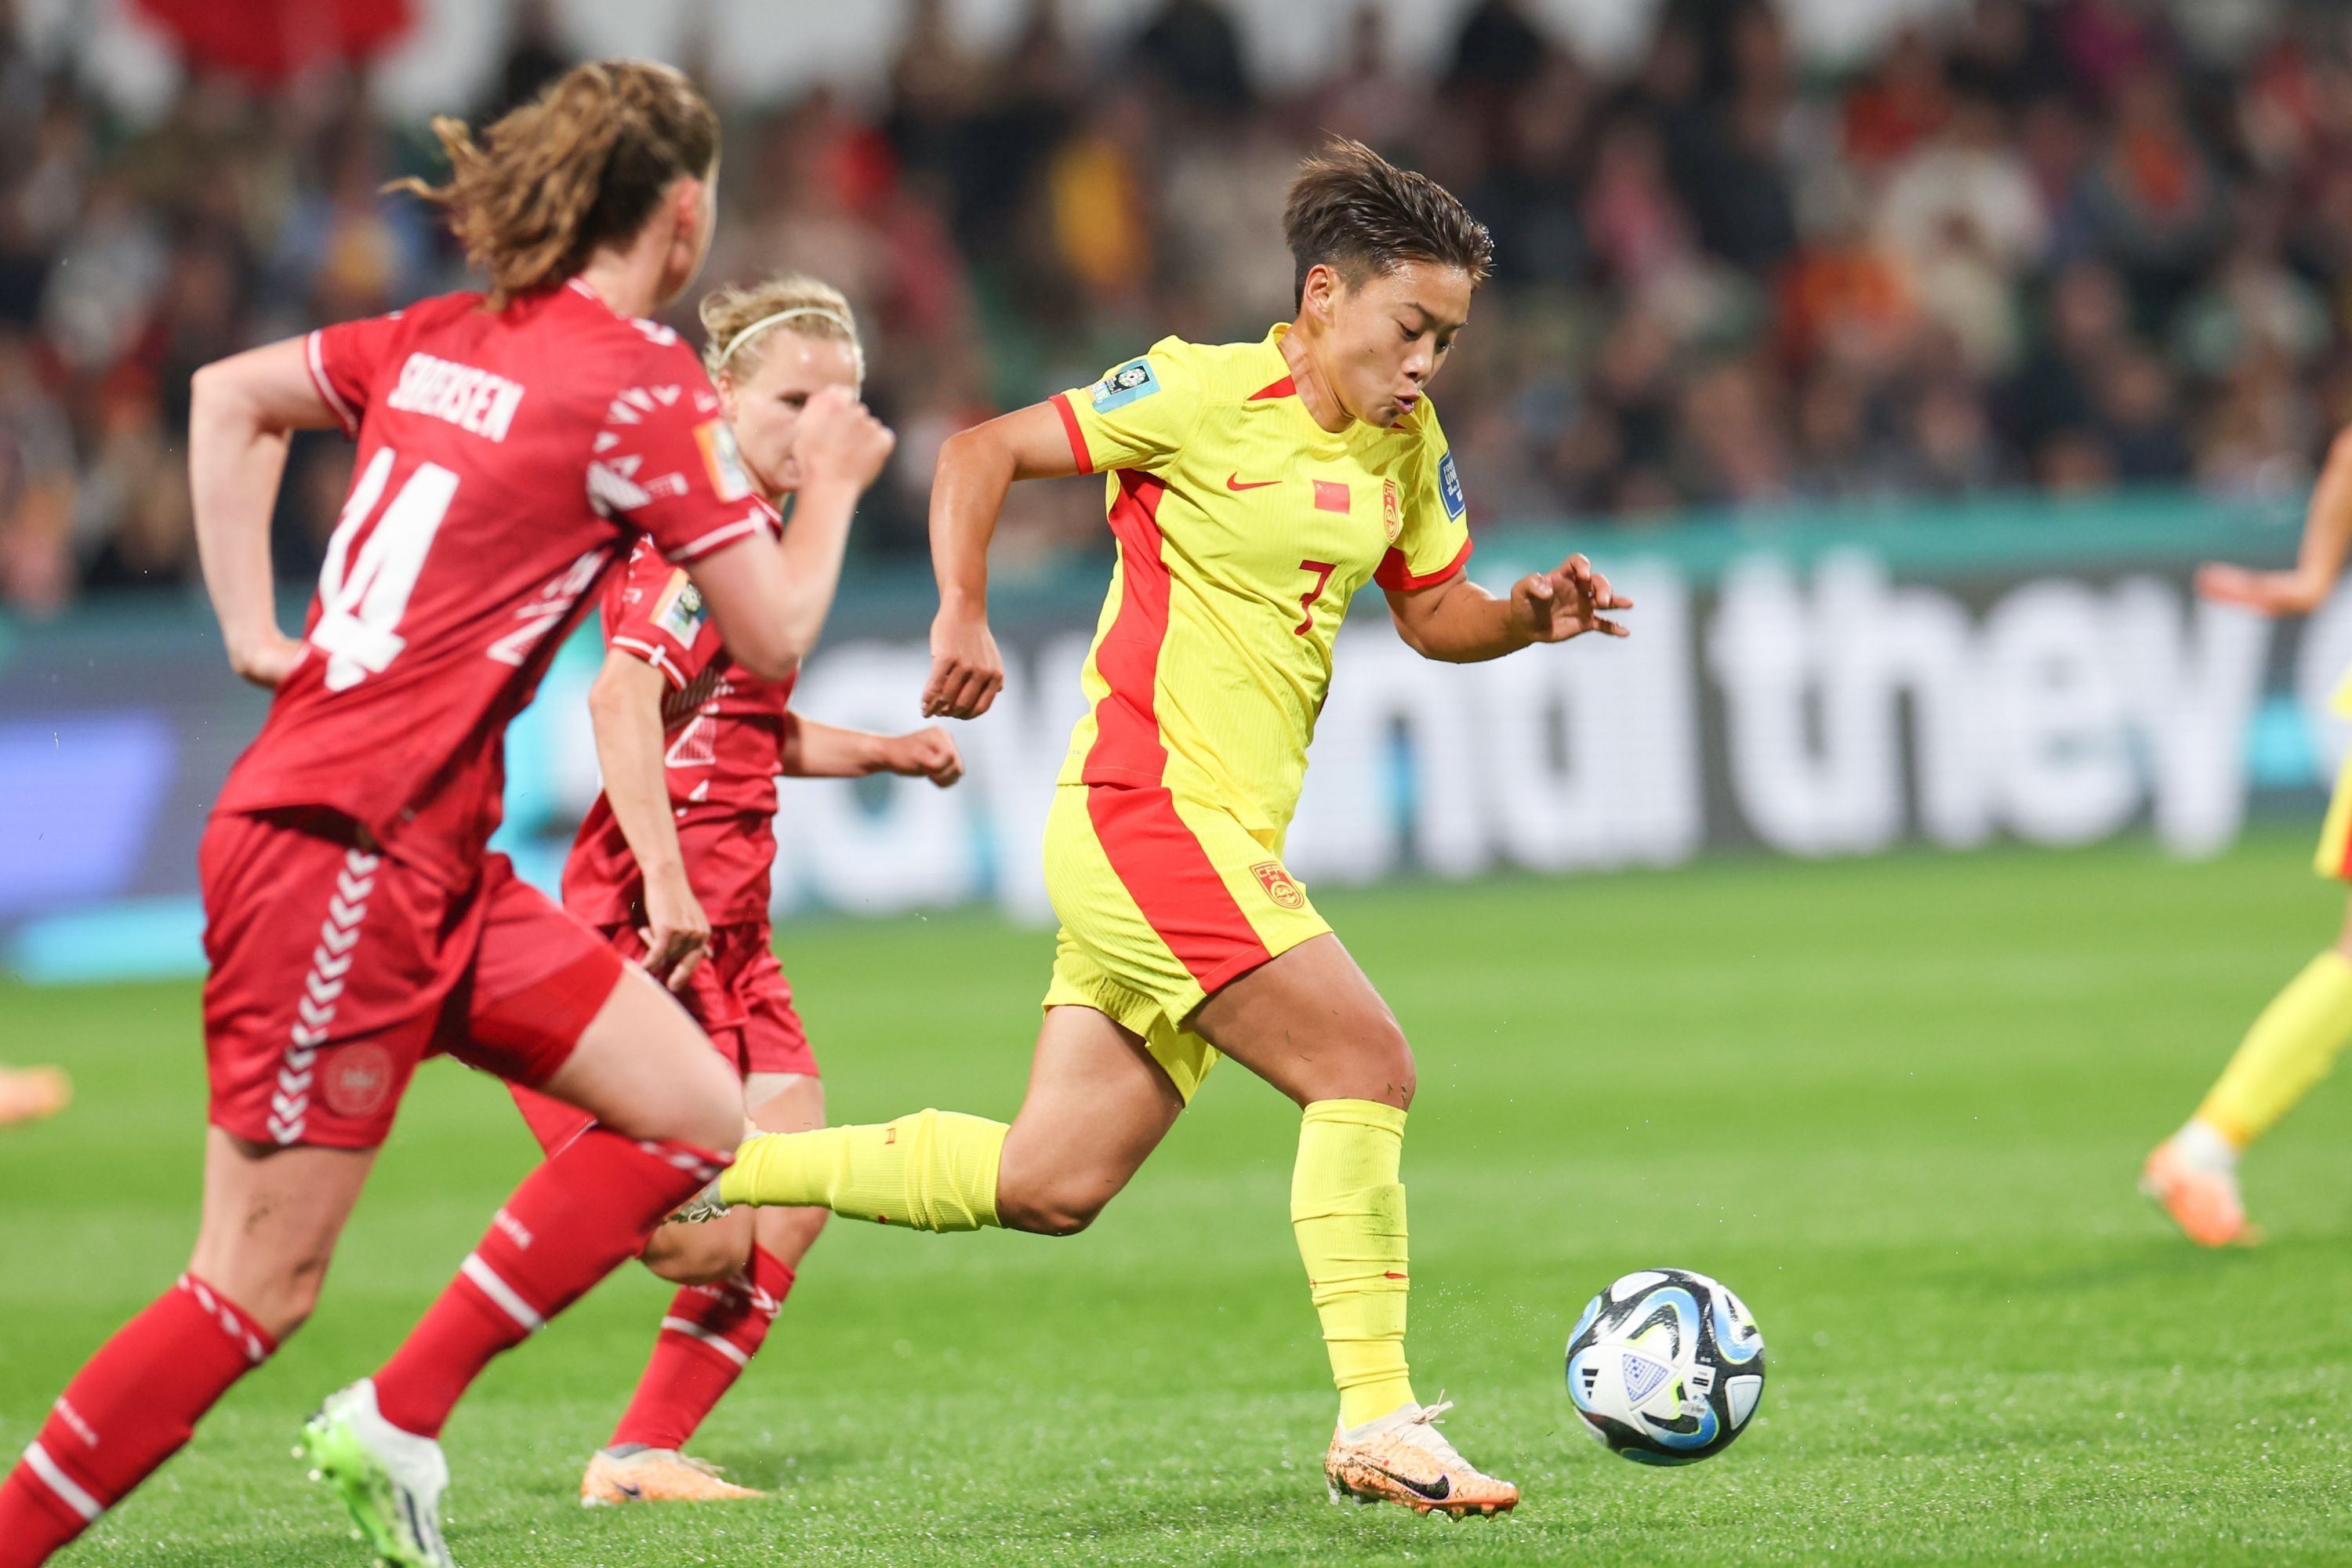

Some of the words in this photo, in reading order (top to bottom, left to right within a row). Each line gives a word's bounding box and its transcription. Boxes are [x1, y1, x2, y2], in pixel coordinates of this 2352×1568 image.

[310, 446, 461, 692] 14
[1294, 559, 1338, 636] 7
[1707, 549, 2267, 864] they
